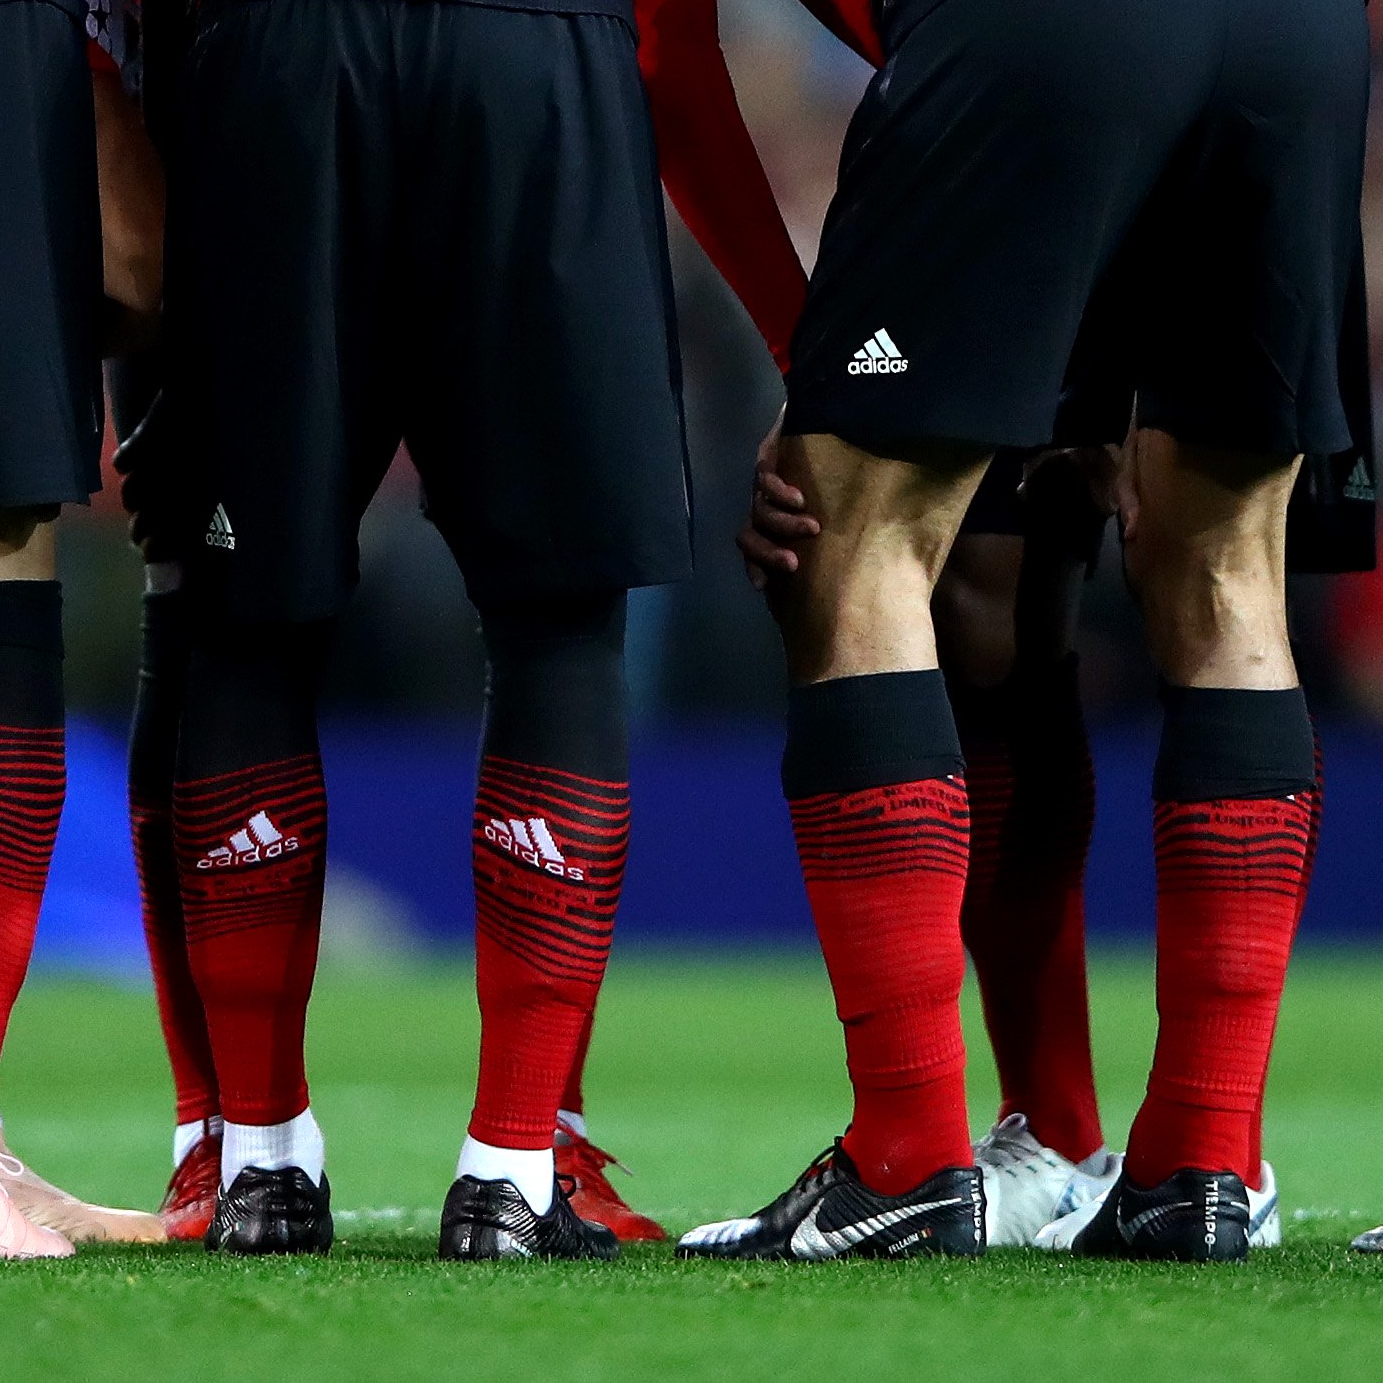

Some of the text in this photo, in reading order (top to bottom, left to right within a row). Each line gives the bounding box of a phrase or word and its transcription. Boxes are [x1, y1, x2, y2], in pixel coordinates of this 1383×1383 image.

[847, 357, 909, 375] adidas
[196, 836, 299, 869] adidas
[484, 825, 584, 881] adidas
[970, 1177, 983, 1243] TIEMPO
[1204, 1180, 1219, 1246] TIEMPO
